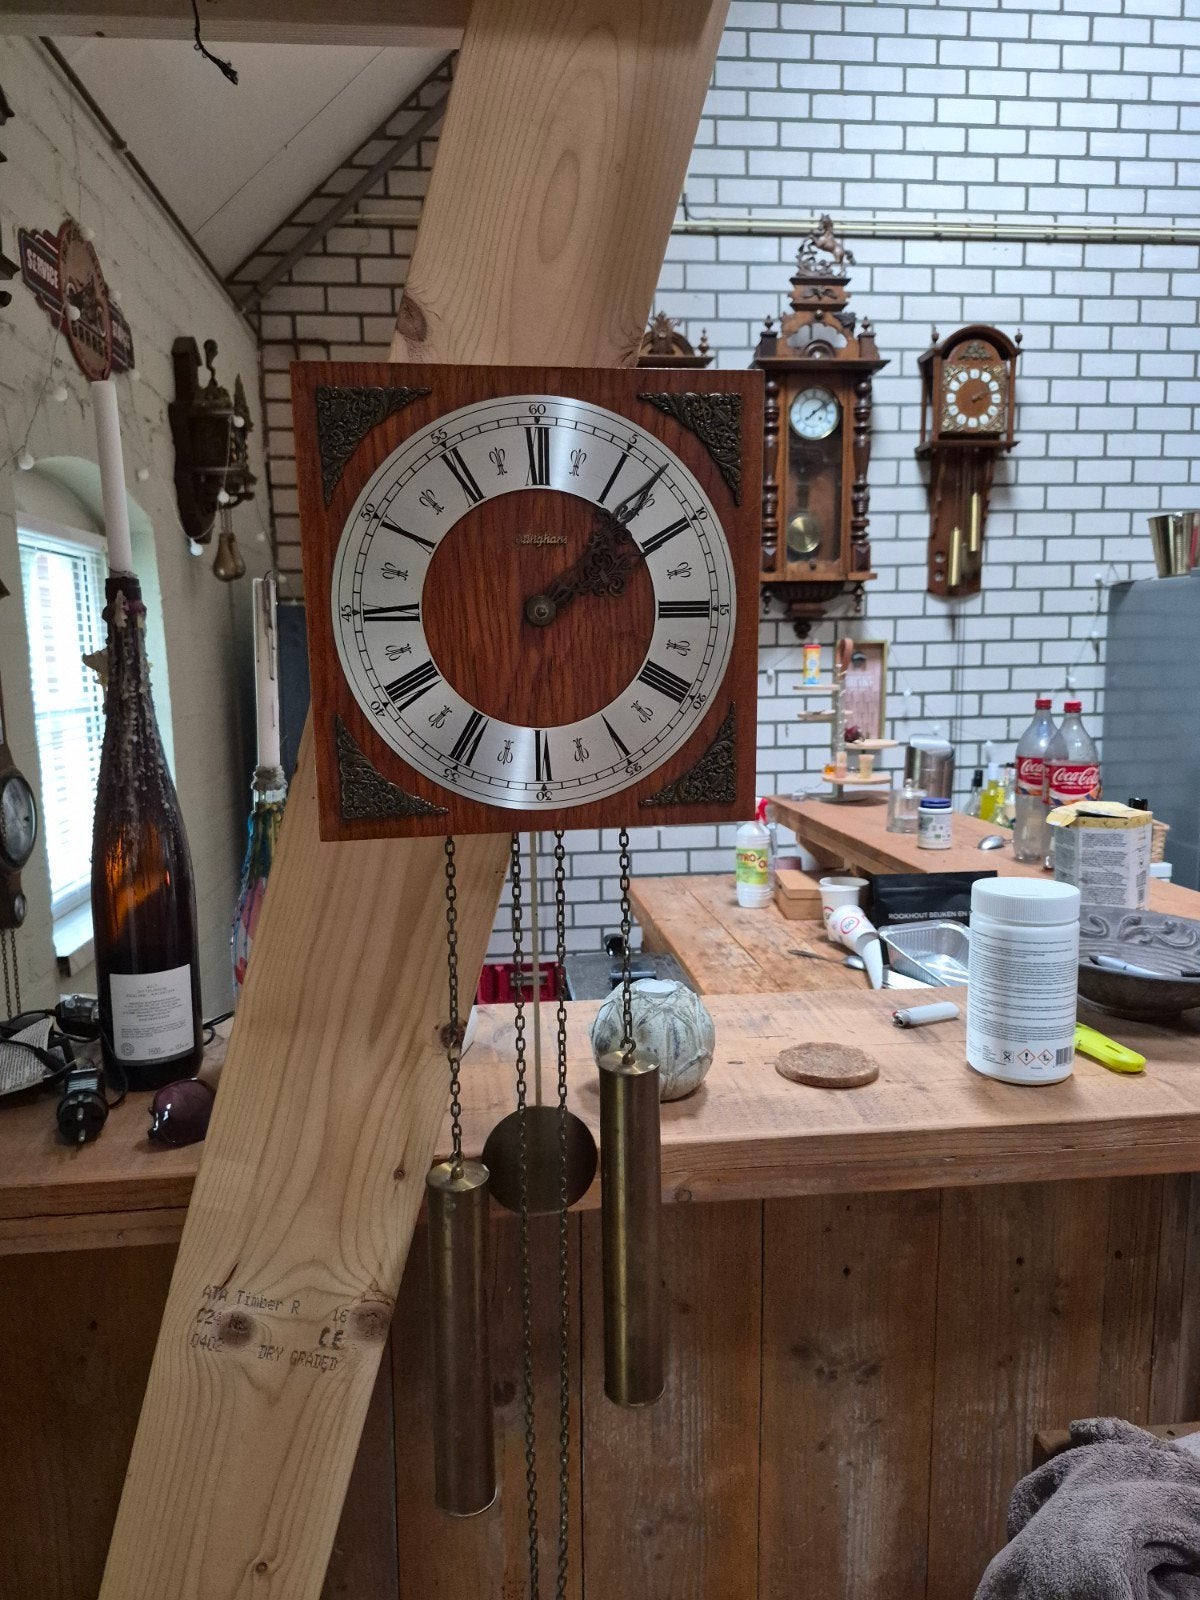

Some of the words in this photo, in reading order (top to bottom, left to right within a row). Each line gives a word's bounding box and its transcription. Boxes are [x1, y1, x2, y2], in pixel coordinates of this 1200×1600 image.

[26, 249, 59, 289] SERVICE
[528, 403, 546, 415] 60
[430, 428, 448, 445] 55
[628, 434, 638, 445] 5
[524, 426, 551, 486] XII
[439, 446, 486, 508] XI
[596, 451, 630, 505] I
[360, 503, 376, 522] 50
[695, 506, 708, 521] 10
[380, 514, 438, 555] X
[639, 514, 693, 556] II
[341, 604, 352, 623] 45
[362, 602, 420, 623] IX
[658, 599, 710, 620] III
[720, 602, 730, 616] 15
[384, 658, 442, 713] VIII
[637, 658, 693, 704] IIII
[370, 701, 385, 718] 40
[693, 693, 707, 710] 20
[449, 709, 490, 767] VII
[601, 713, 632, 761] V
[534, 730, 553, 782] VI
[442, 767, 461, 783] 35
[625, 762, 643, 777] 25
[536, 790, 553, 801] 30
[888, 912, 927, 920] ROOKHOUT
[202, 1285, 228, 1302] ATA
[236, 1289, 284, 1311] Timber
[291, 1300, 300, 1315] R
[333, 1306, 350, 1323] 16
[319, 1326, 344, 1350] CE
[190, 1333, 224, 1353] 0402
[257, 1344, 284, 1361] DRY
[290, 1350, 338, 1371] GRADED
